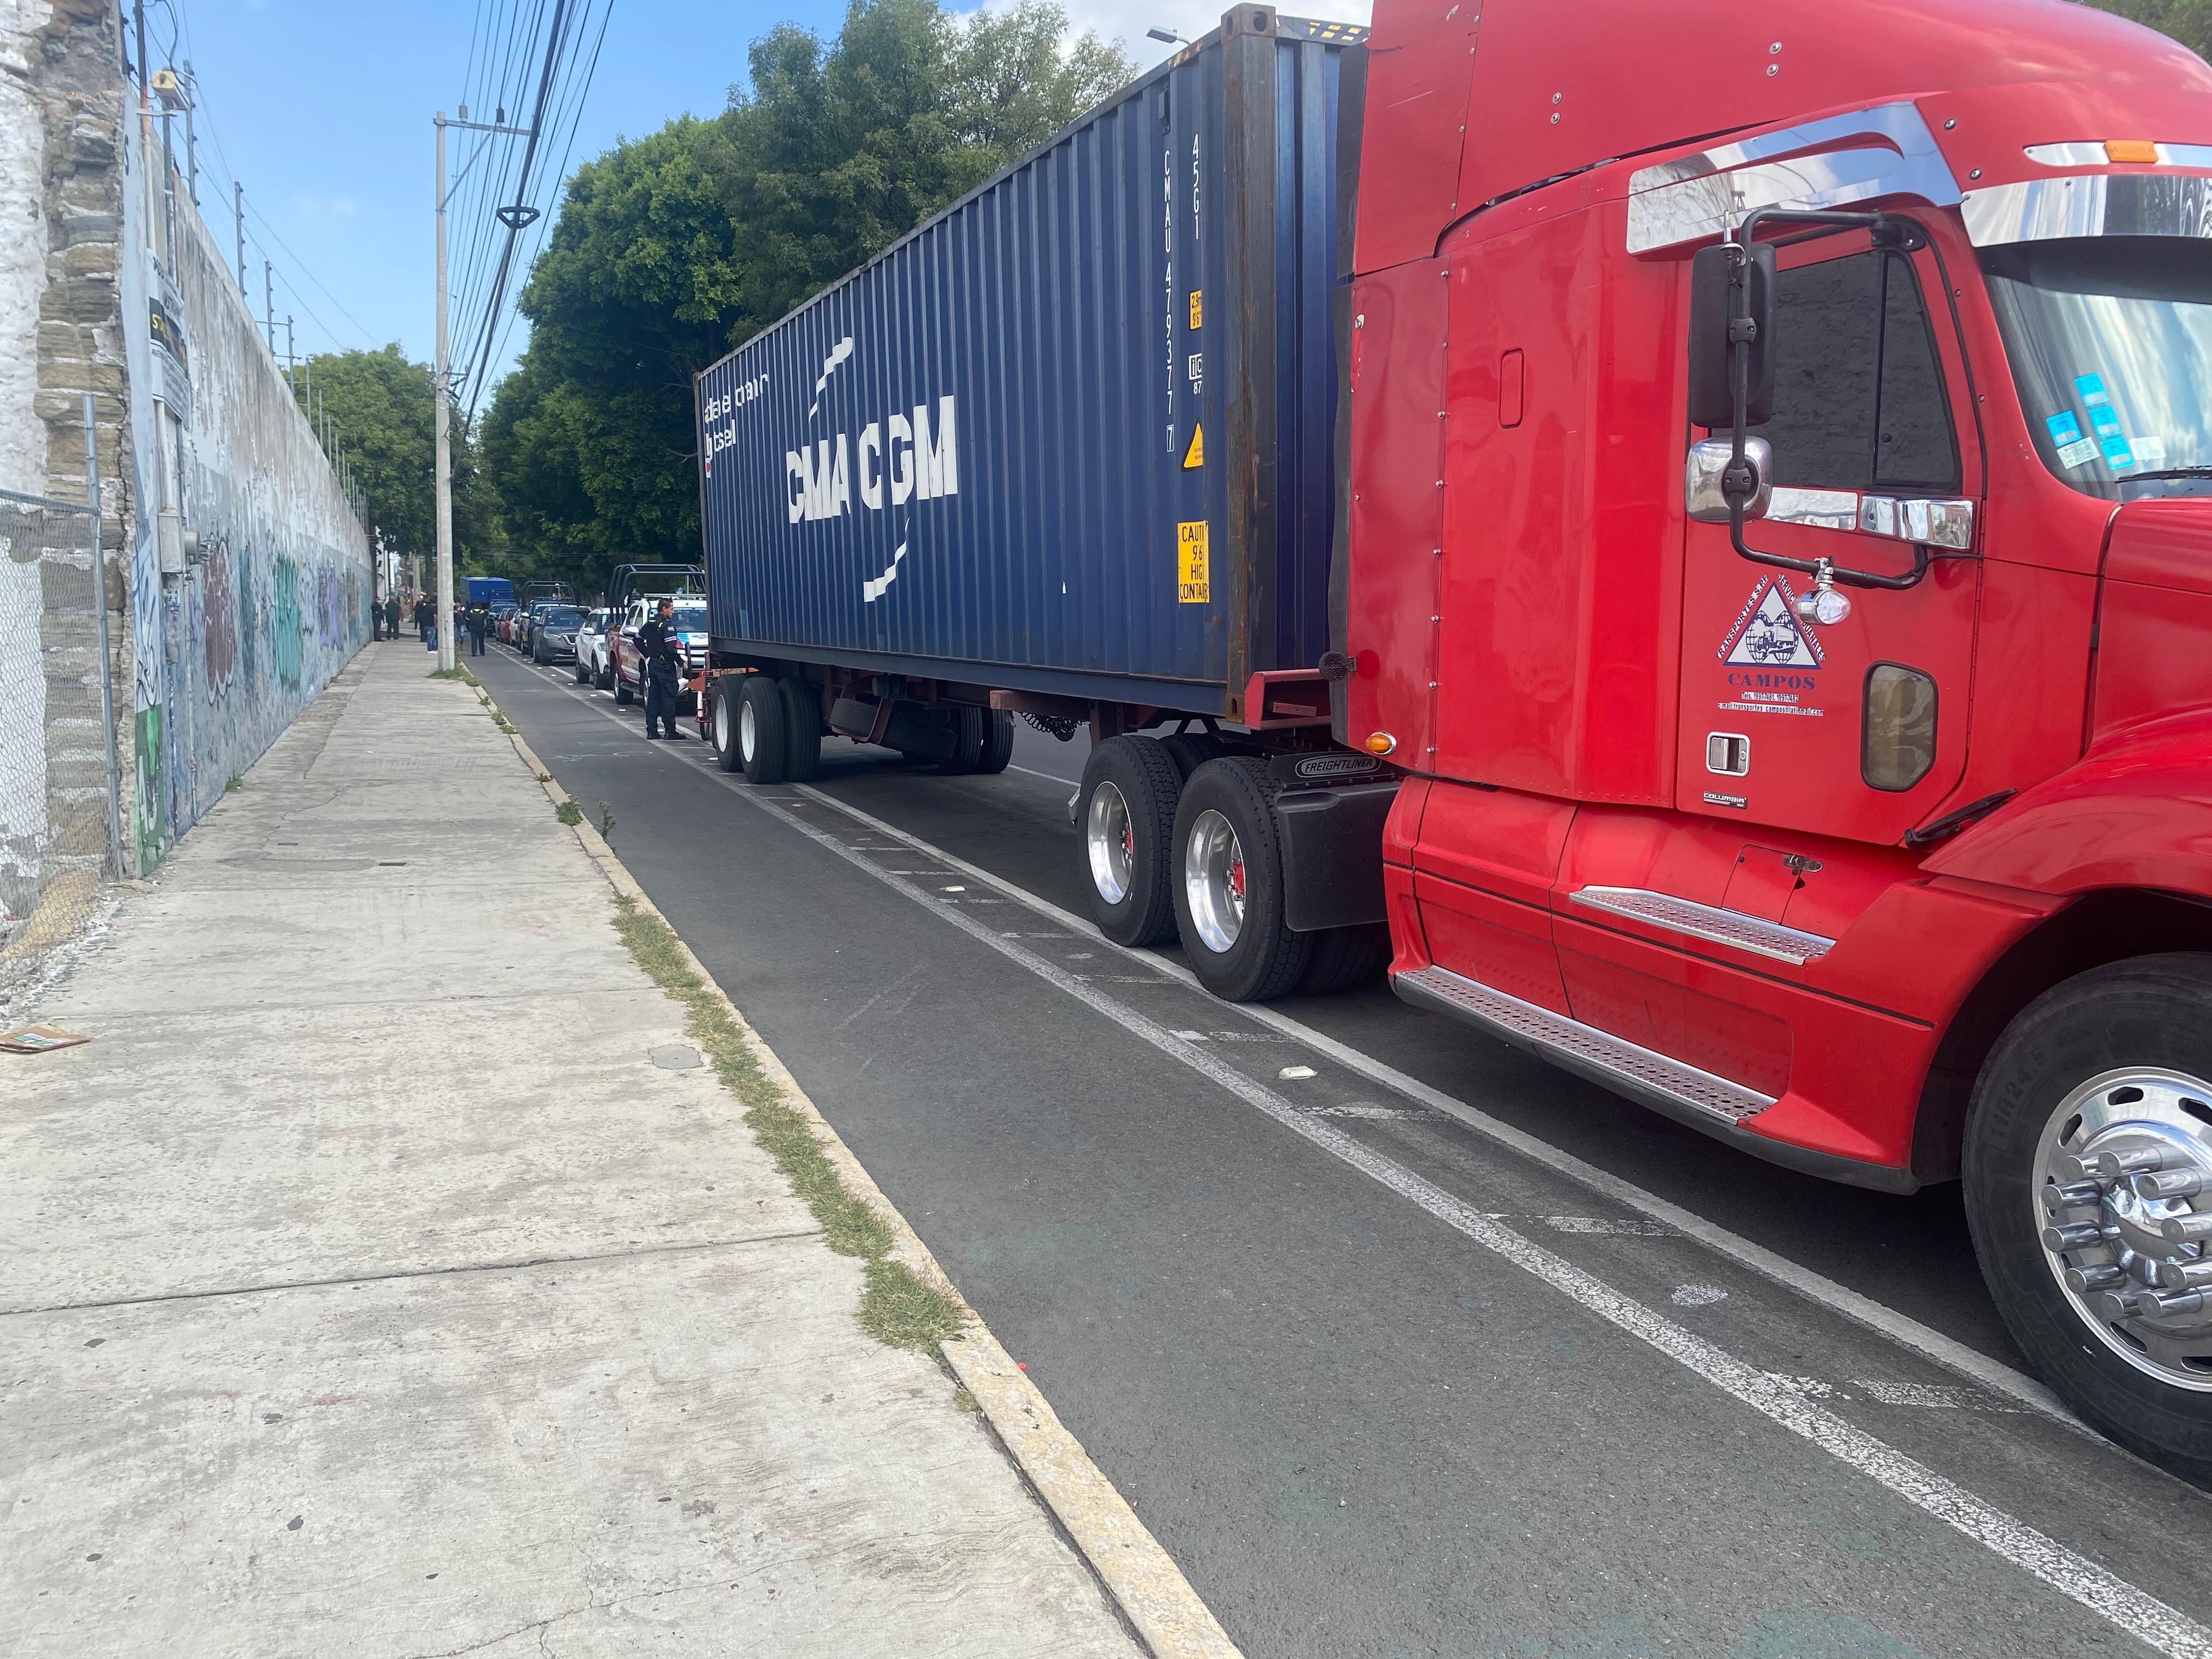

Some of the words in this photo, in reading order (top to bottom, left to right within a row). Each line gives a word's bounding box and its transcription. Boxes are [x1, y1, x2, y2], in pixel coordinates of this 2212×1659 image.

[1193, 381, 1202, 394] 87
[786, 433, 851, 524] CMA
[859, 395, 958, 510] CGM
[1716, 595, 1756, 659] TRANSPORTES
[1728, 673, 1815, 690] CAMPOS
[1305, 759, 1373, 773] FREIGHTLINER
[1703, 793, 1745, 804] COLUMBIA
